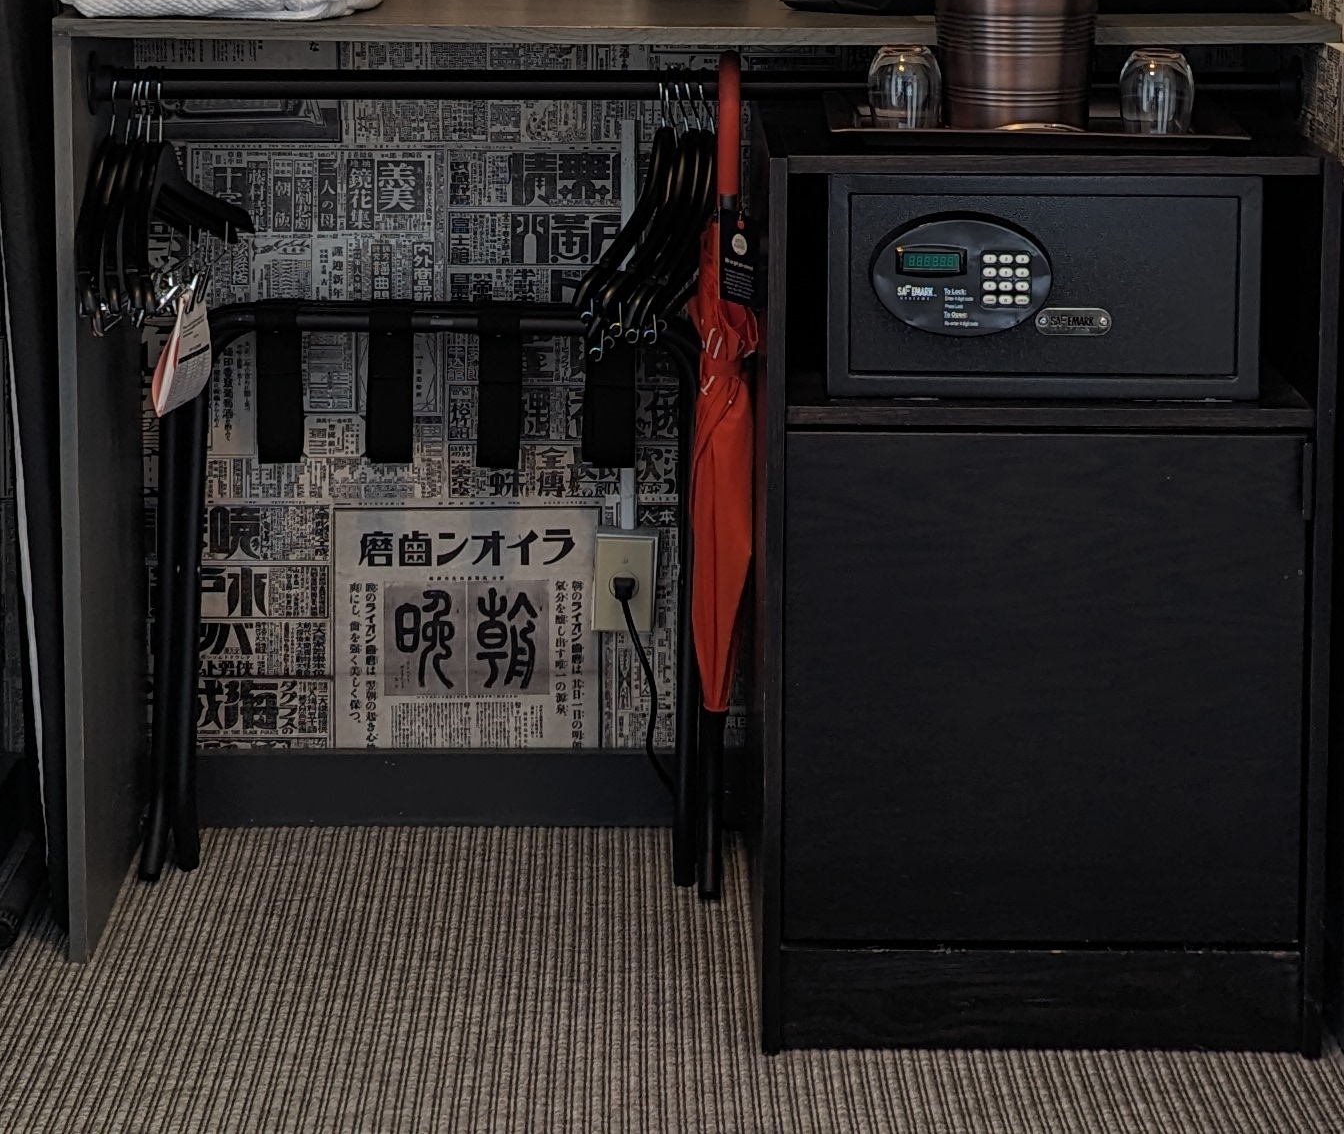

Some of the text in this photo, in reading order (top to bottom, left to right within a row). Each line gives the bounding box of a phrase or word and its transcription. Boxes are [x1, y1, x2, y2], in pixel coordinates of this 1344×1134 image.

[318, 162, 336, 228] 三人の母
[348, 168, 373, 229] 鏡花集
